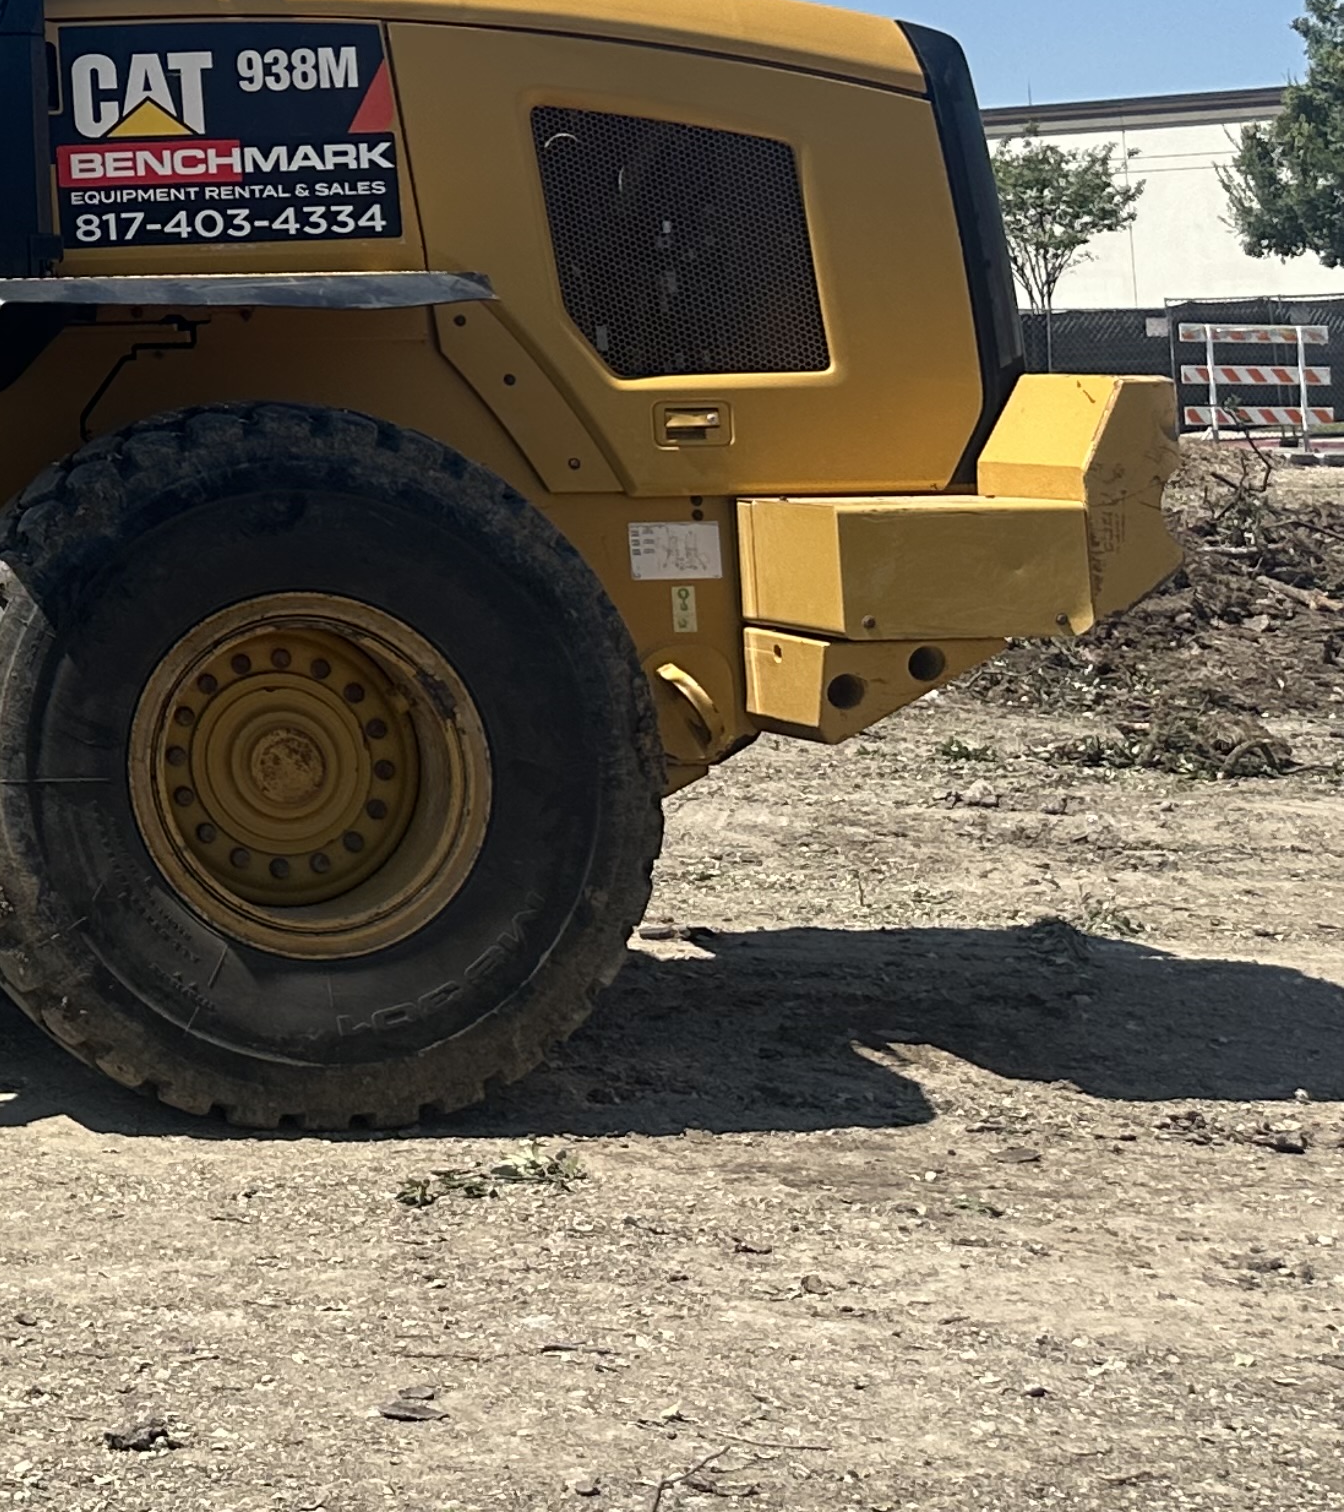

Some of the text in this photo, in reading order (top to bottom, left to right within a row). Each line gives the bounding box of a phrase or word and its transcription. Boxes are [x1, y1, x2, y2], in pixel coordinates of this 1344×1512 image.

[71, 46, 359, 138] CAT 938M
[70, 141, 395, 179] BENCHMARK
[70, 181, 386, 205] EQUIPMENT RENTAL & SALES
[75, 203, 387, 242] 817-403-4334
